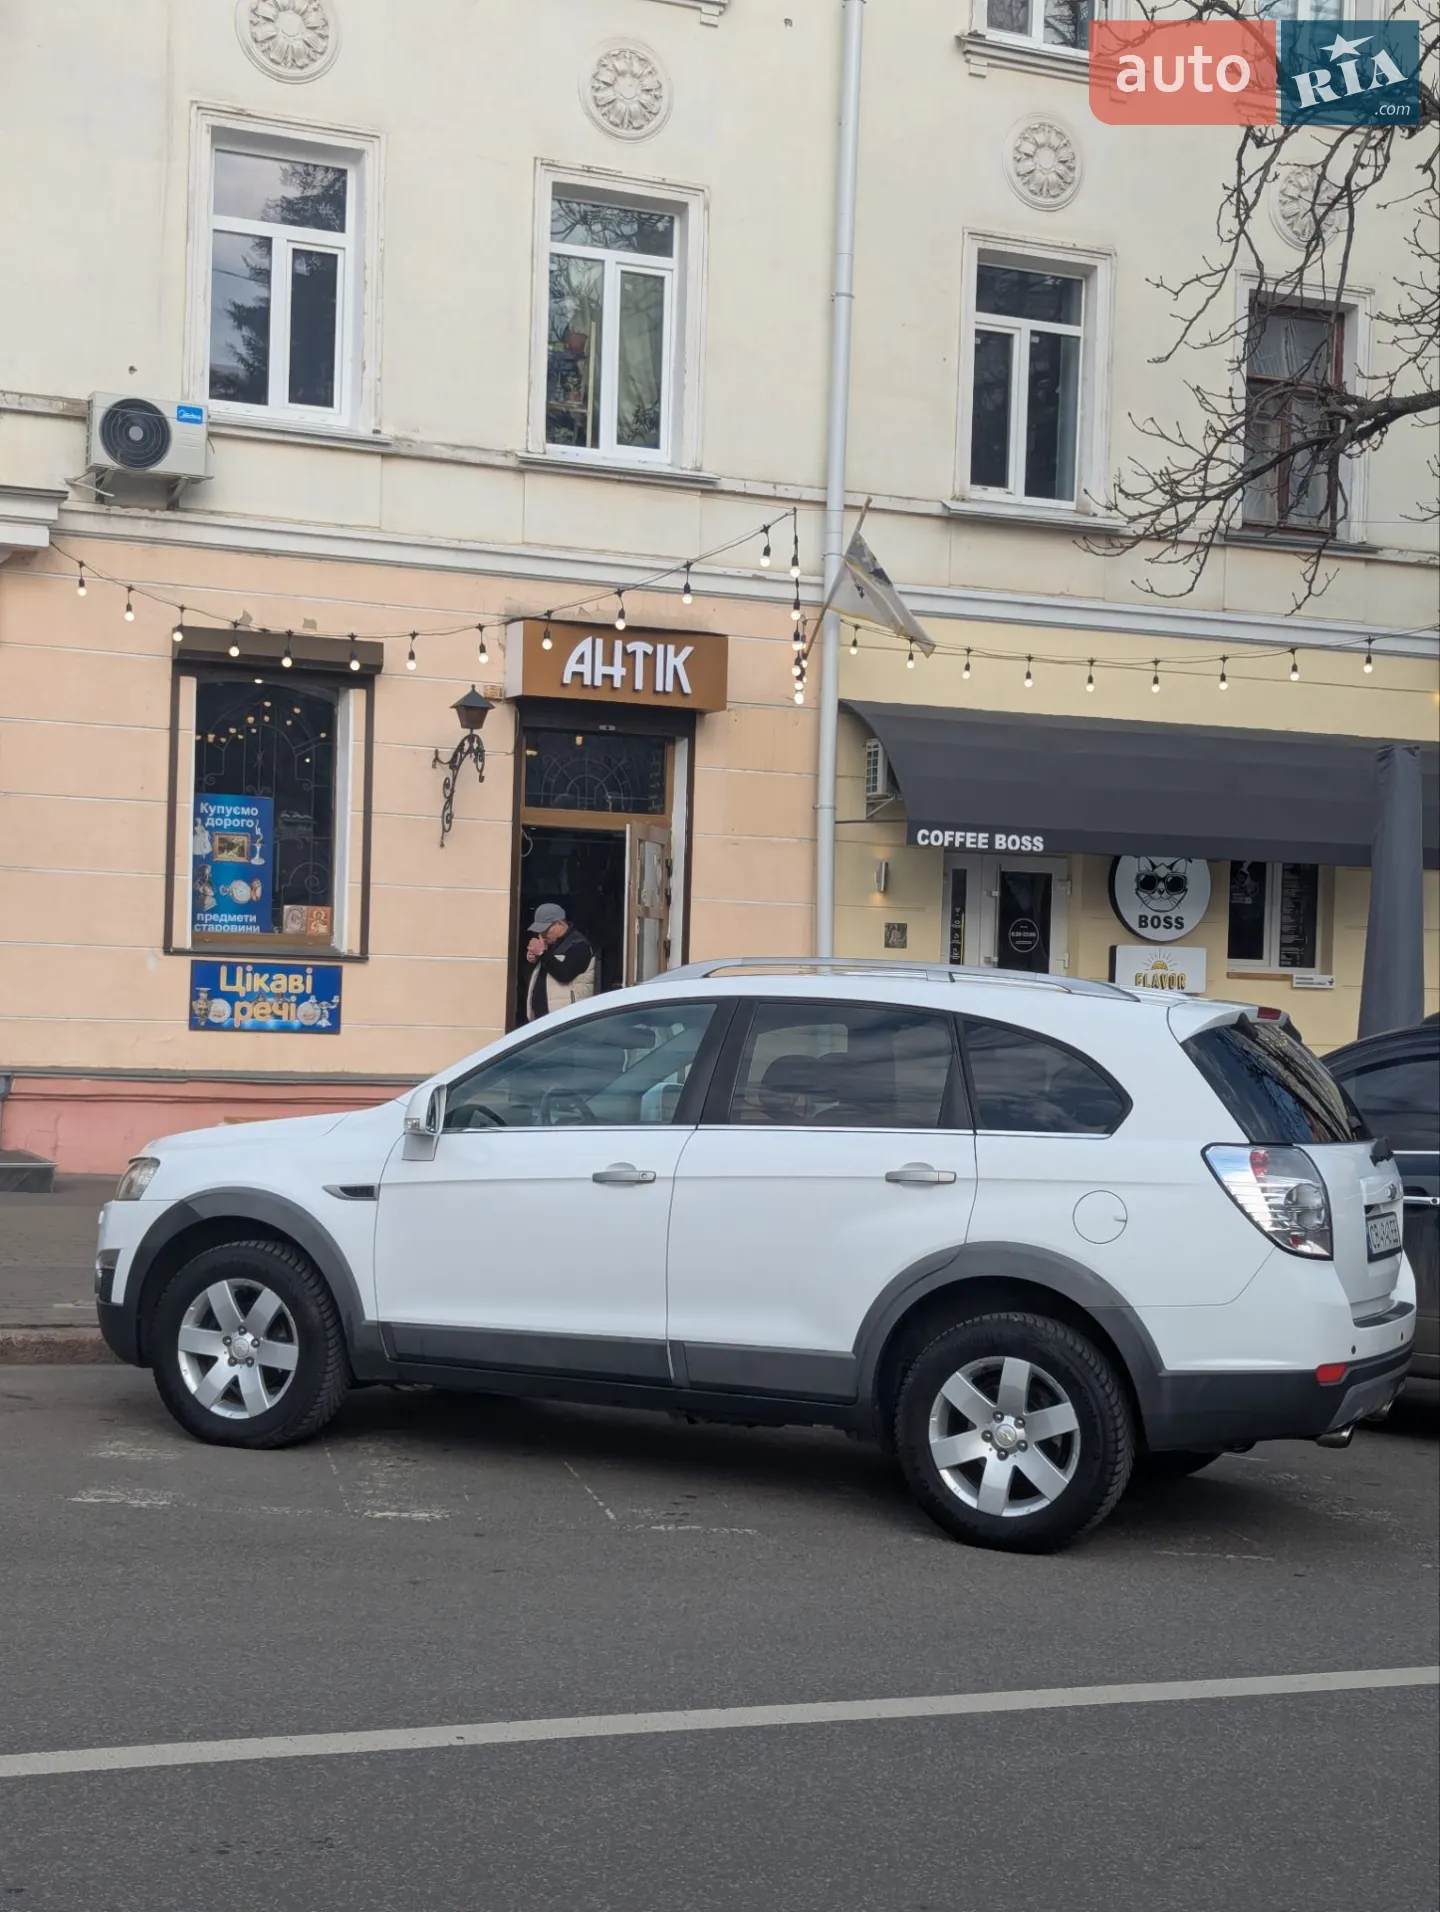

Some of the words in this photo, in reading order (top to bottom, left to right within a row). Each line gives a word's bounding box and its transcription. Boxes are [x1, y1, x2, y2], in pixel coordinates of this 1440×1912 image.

[562, 636, 694, 695] АНТІК
[200, 801, 259, 817] Купуємо
[205, 817, 255, 829] дорого
[917, 829, 989, 849] COFFEE
[994, 834, 1045, 852] BOSS
[196, 913, 257, 923] предмети
[1138, 914, 1185, 930] BOSS
[194, 923, 261, 933] старовини
[219, 965, 313, 997] Цікаві
[1134, 972, 1188, 991] FLAVOR
[234, 995, 297, 1028] речі
